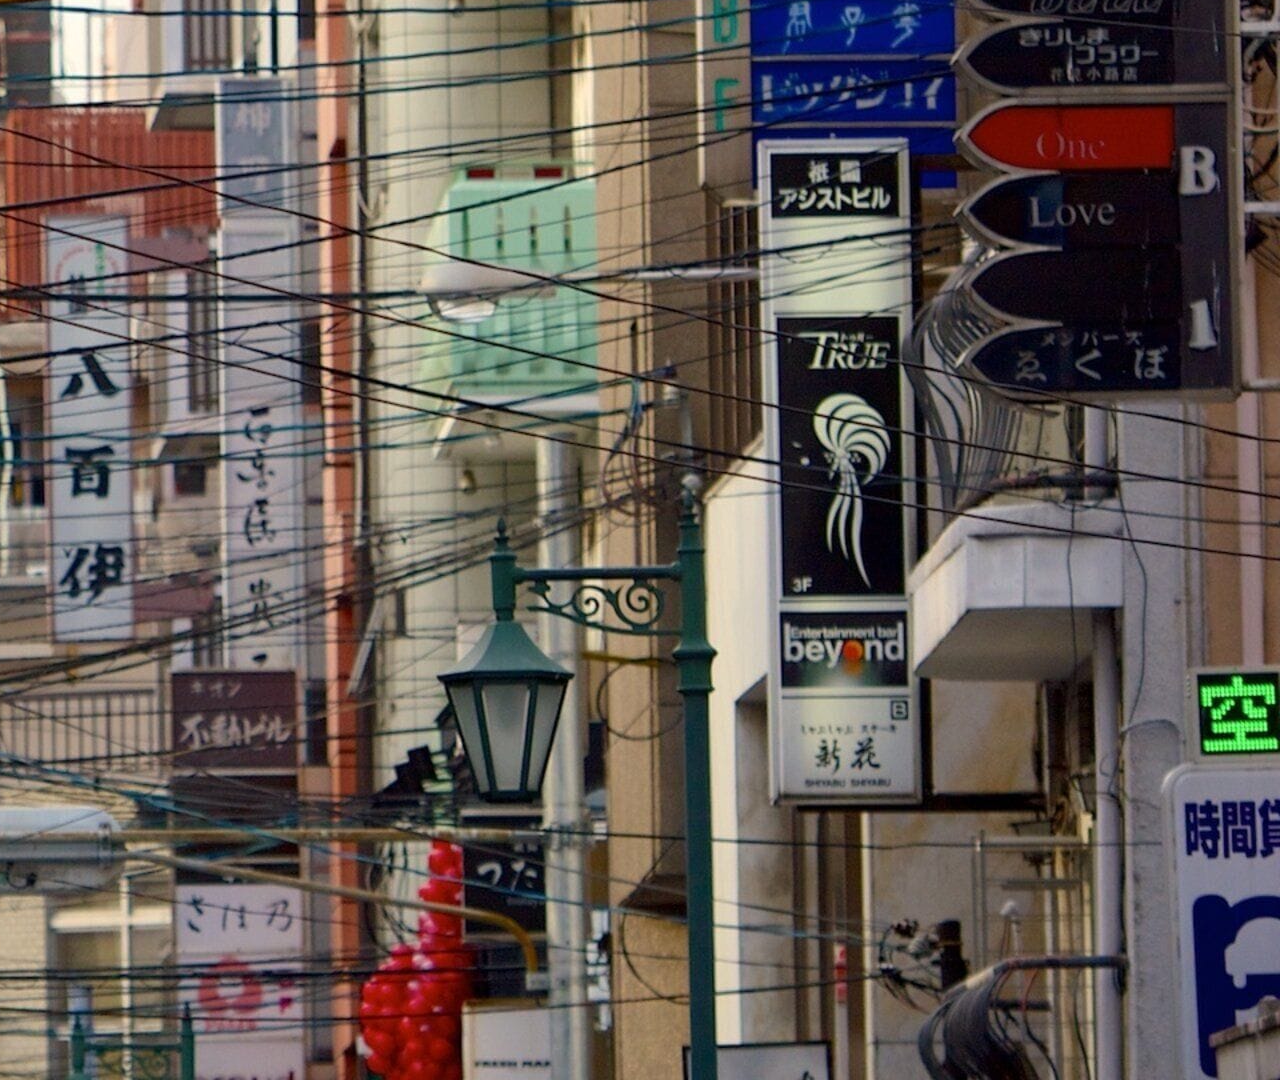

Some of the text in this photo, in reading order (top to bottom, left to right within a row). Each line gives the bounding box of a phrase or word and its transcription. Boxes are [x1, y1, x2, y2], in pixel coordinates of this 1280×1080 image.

[1036, 131, 1106, 160] One
[779, 187, 891, 211] アシストビル
[1030, 196, 1116, 228] Love
[797, 331, 891, 370] TRUE
[57, 350, 123, 606] 八百伊
[792, 576, 813, 592] 3F
[784, 622, 904, 668] beyond
[1199, 675, 1280, 752] 空
